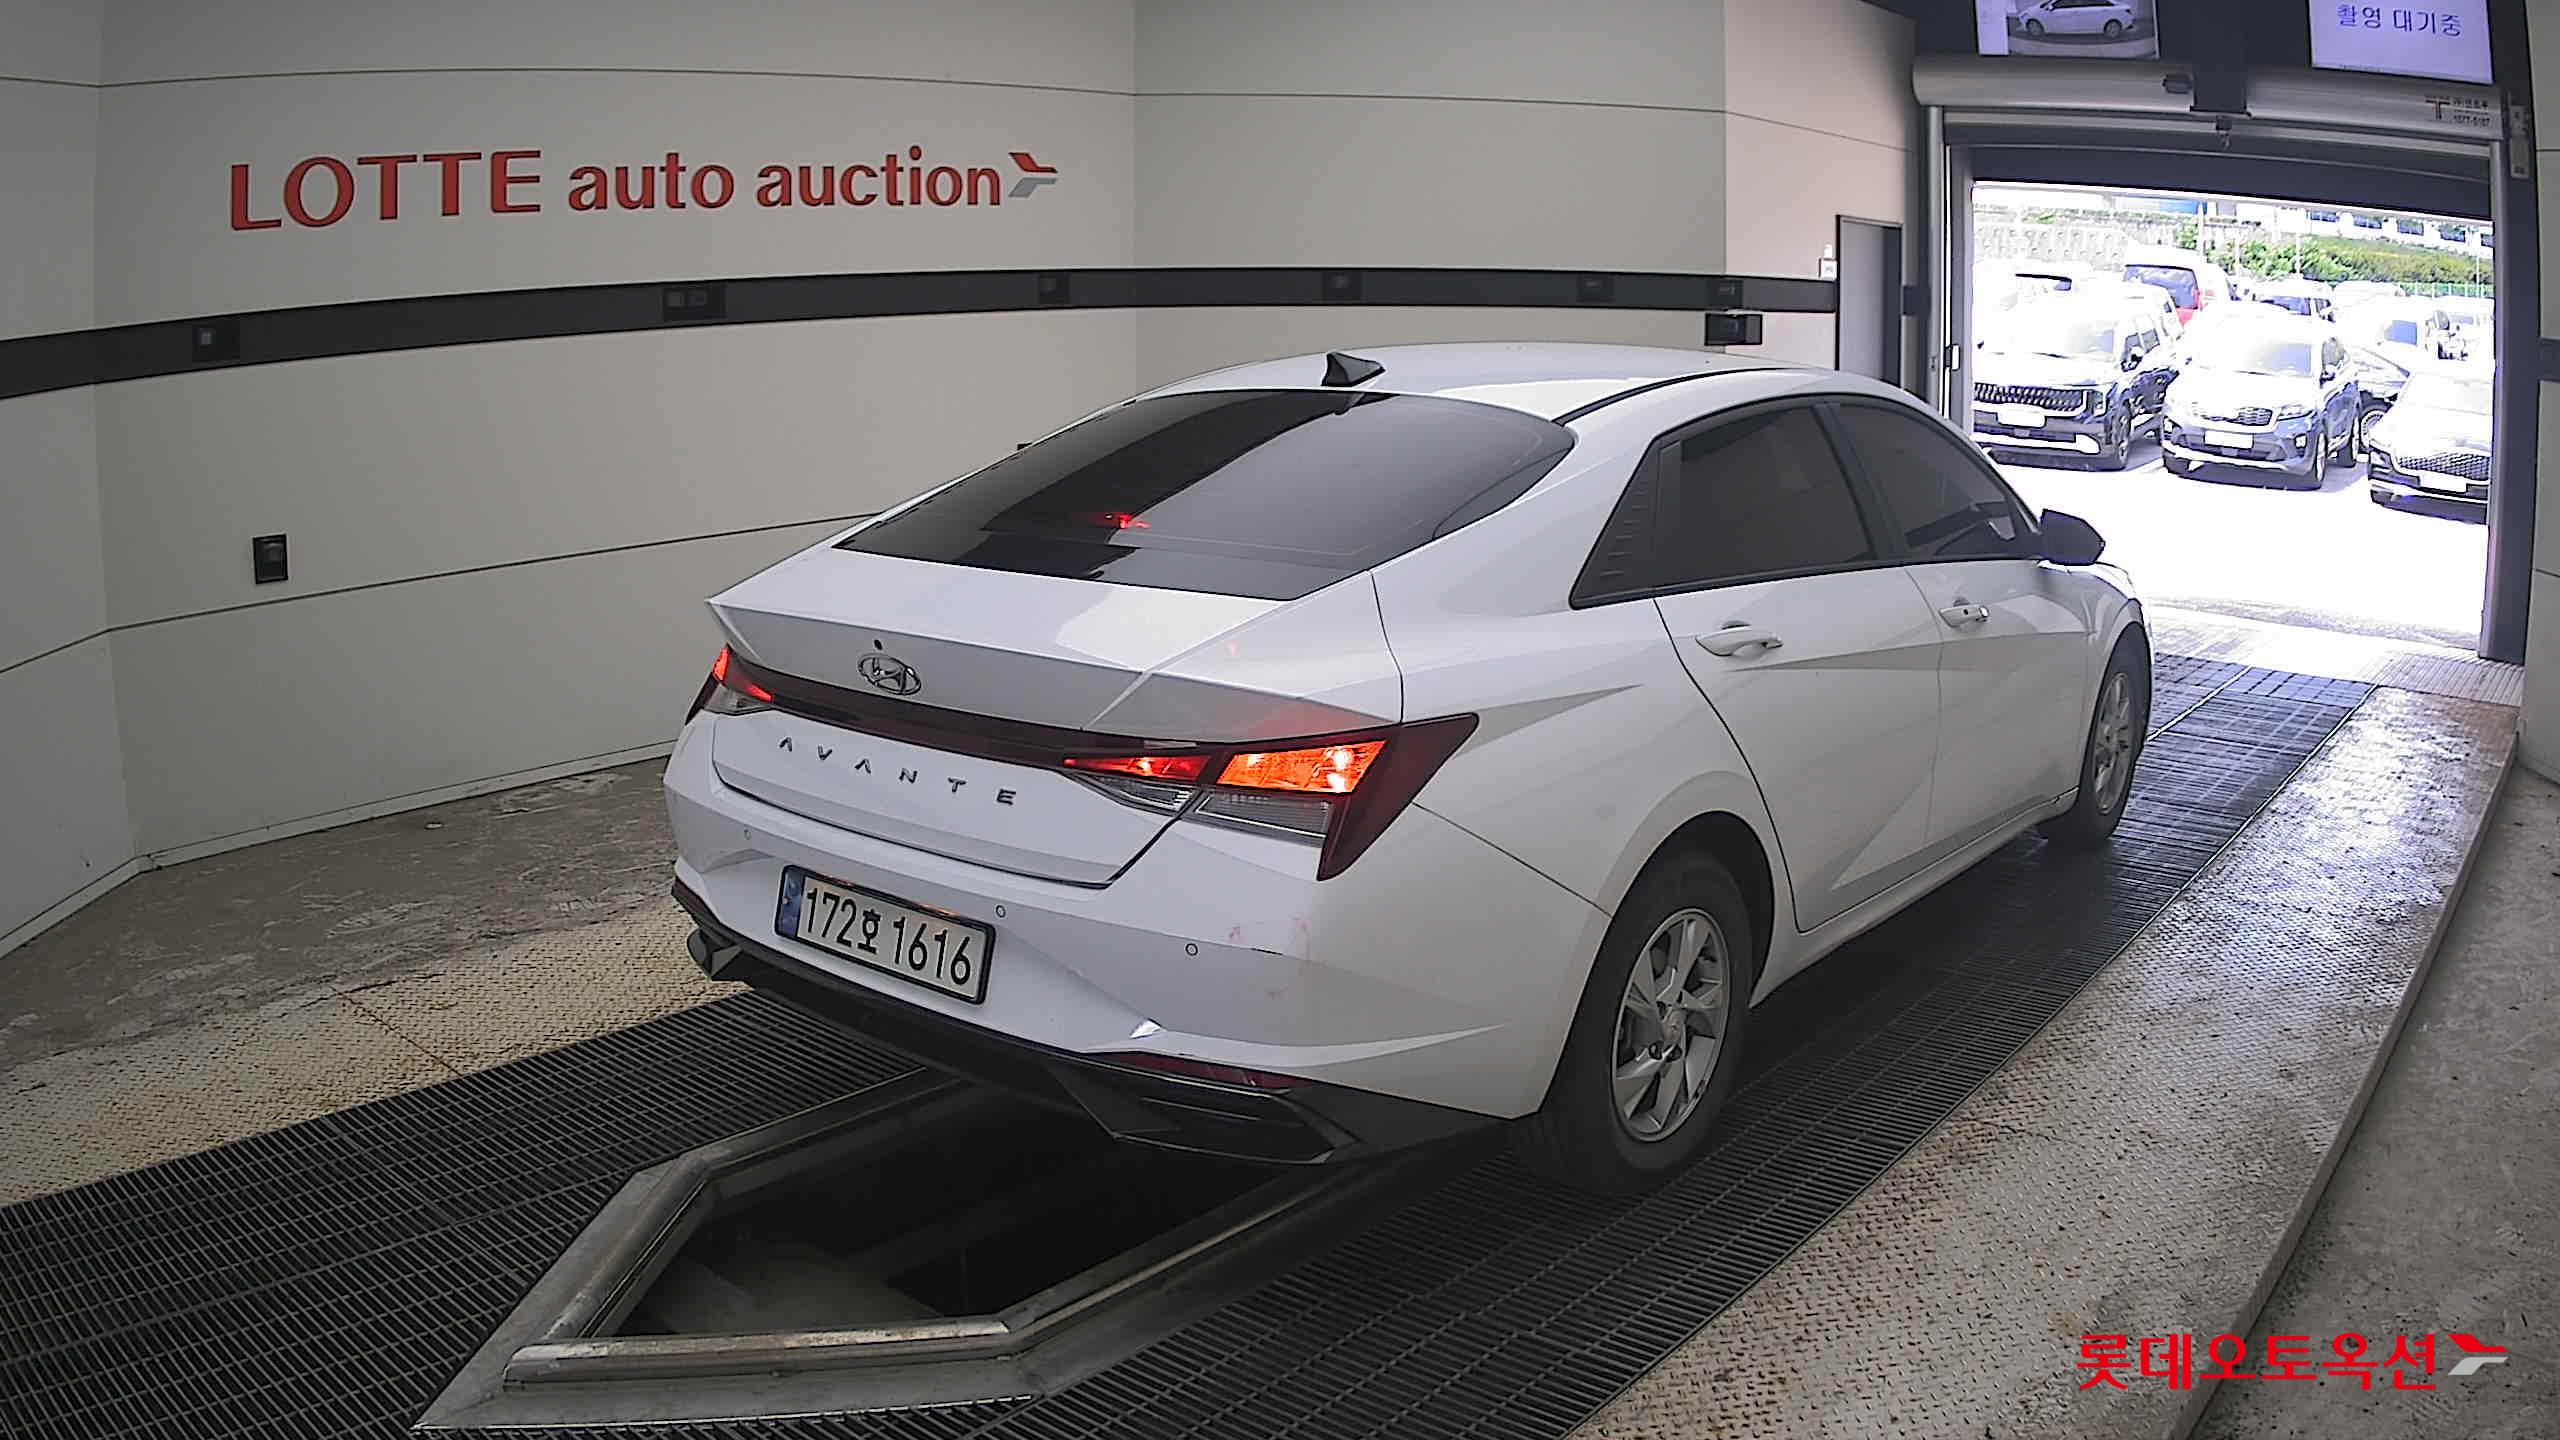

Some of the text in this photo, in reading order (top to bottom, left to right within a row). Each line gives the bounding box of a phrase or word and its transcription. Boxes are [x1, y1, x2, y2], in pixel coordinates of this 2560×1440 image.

[2337, 4, 2462, 37] 촬영 대기중
[230, 146, 1002, 231] LOTTE auto auction
[779, 737, 1016, 805] AVANTE
[893, 916, 971, 985] 1616
